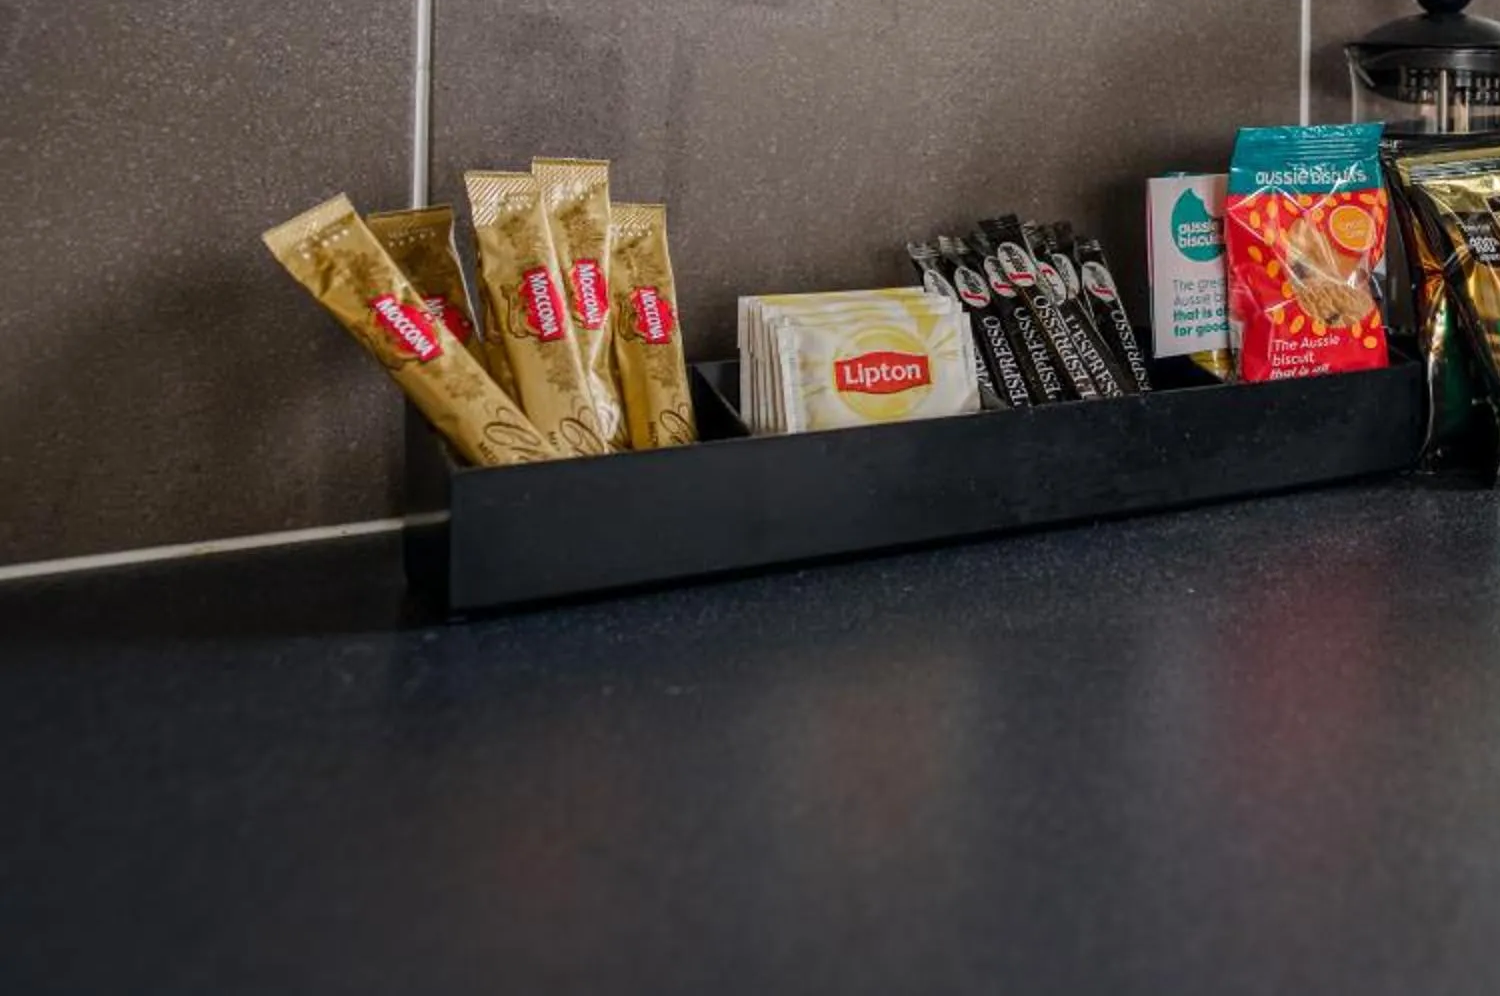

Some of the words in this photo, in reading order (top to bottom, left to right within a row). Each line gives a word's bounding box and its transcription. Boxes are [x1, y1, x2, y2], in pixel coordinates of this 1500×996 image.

[375, 297, 436, 357] MOCCONA
[529, 271, 559, 338] MOCCONA
[842, 362, 922, 388] Lipton
